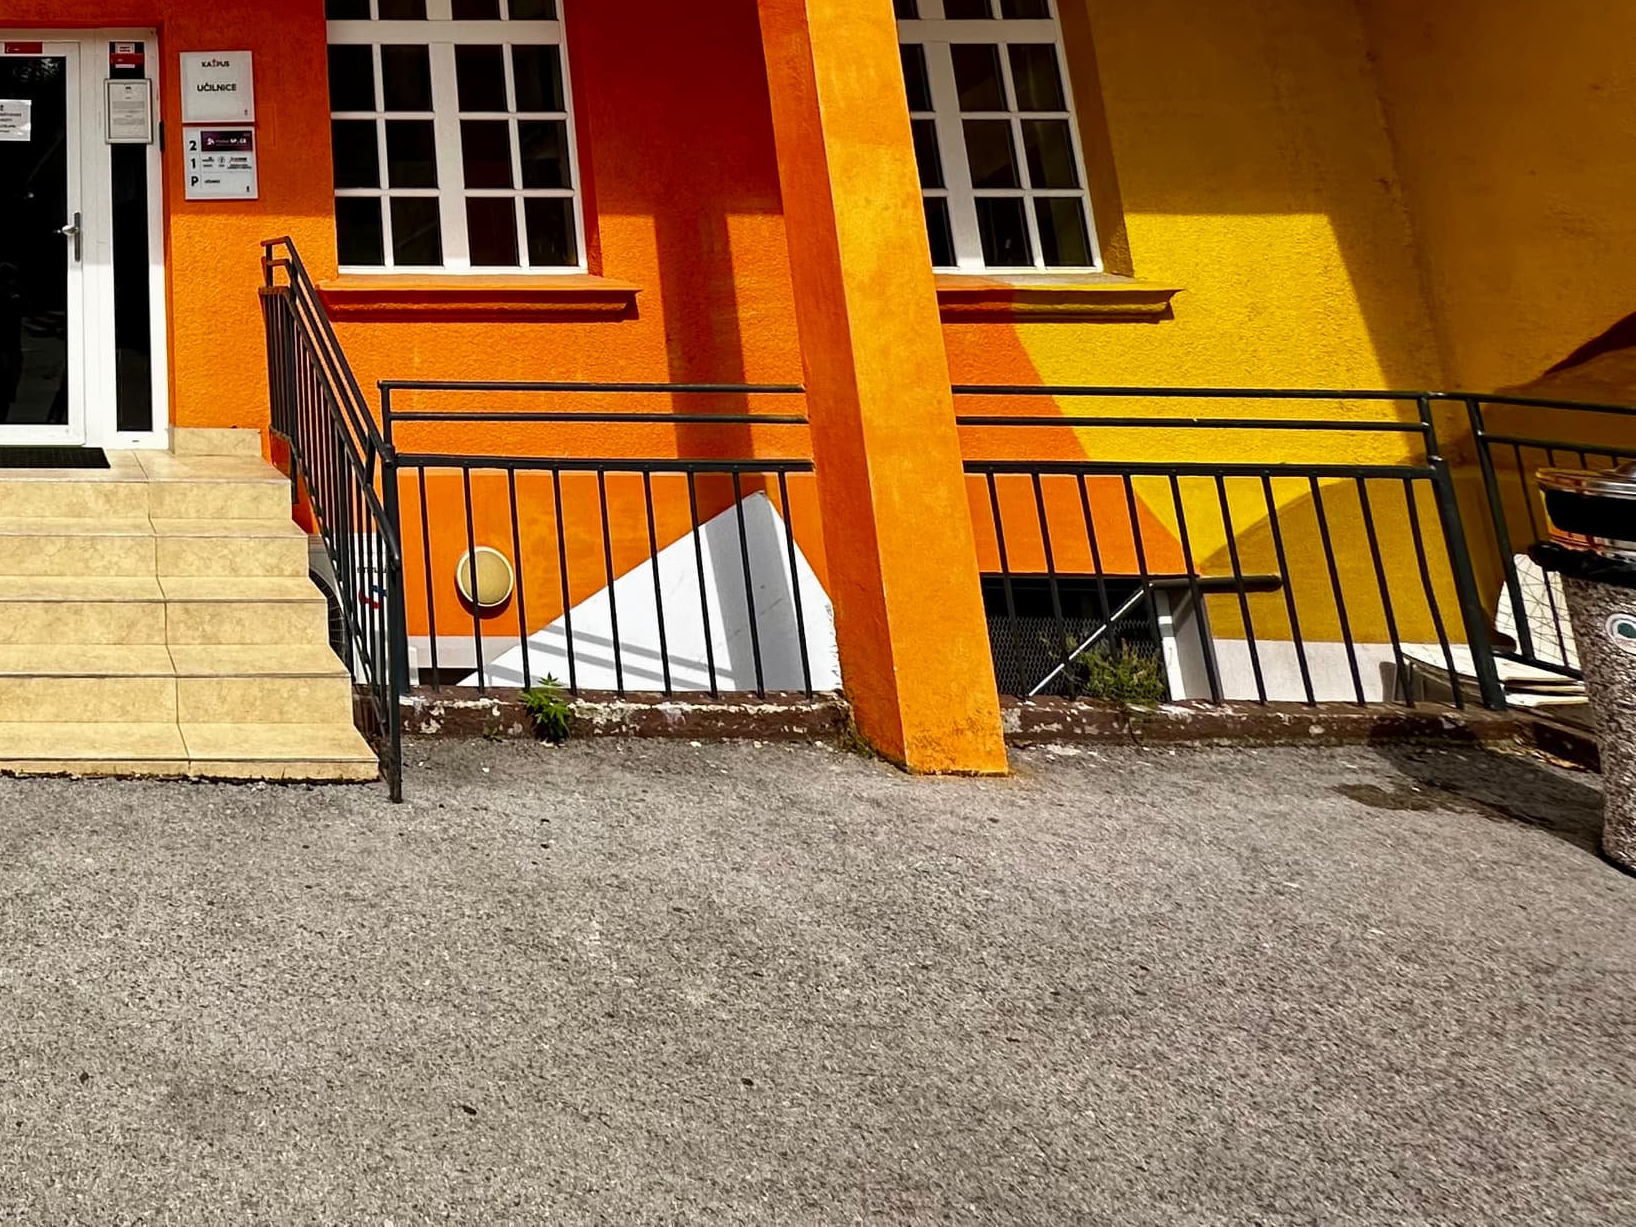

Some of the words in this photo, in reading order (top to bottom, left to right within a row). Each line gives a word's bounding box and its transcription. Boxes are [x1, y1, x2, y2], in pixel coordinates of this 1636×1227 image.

[189, 140, 197, 151] 2
[191, 158, 196, 169] 1
[191, 176, 199, 187] P
